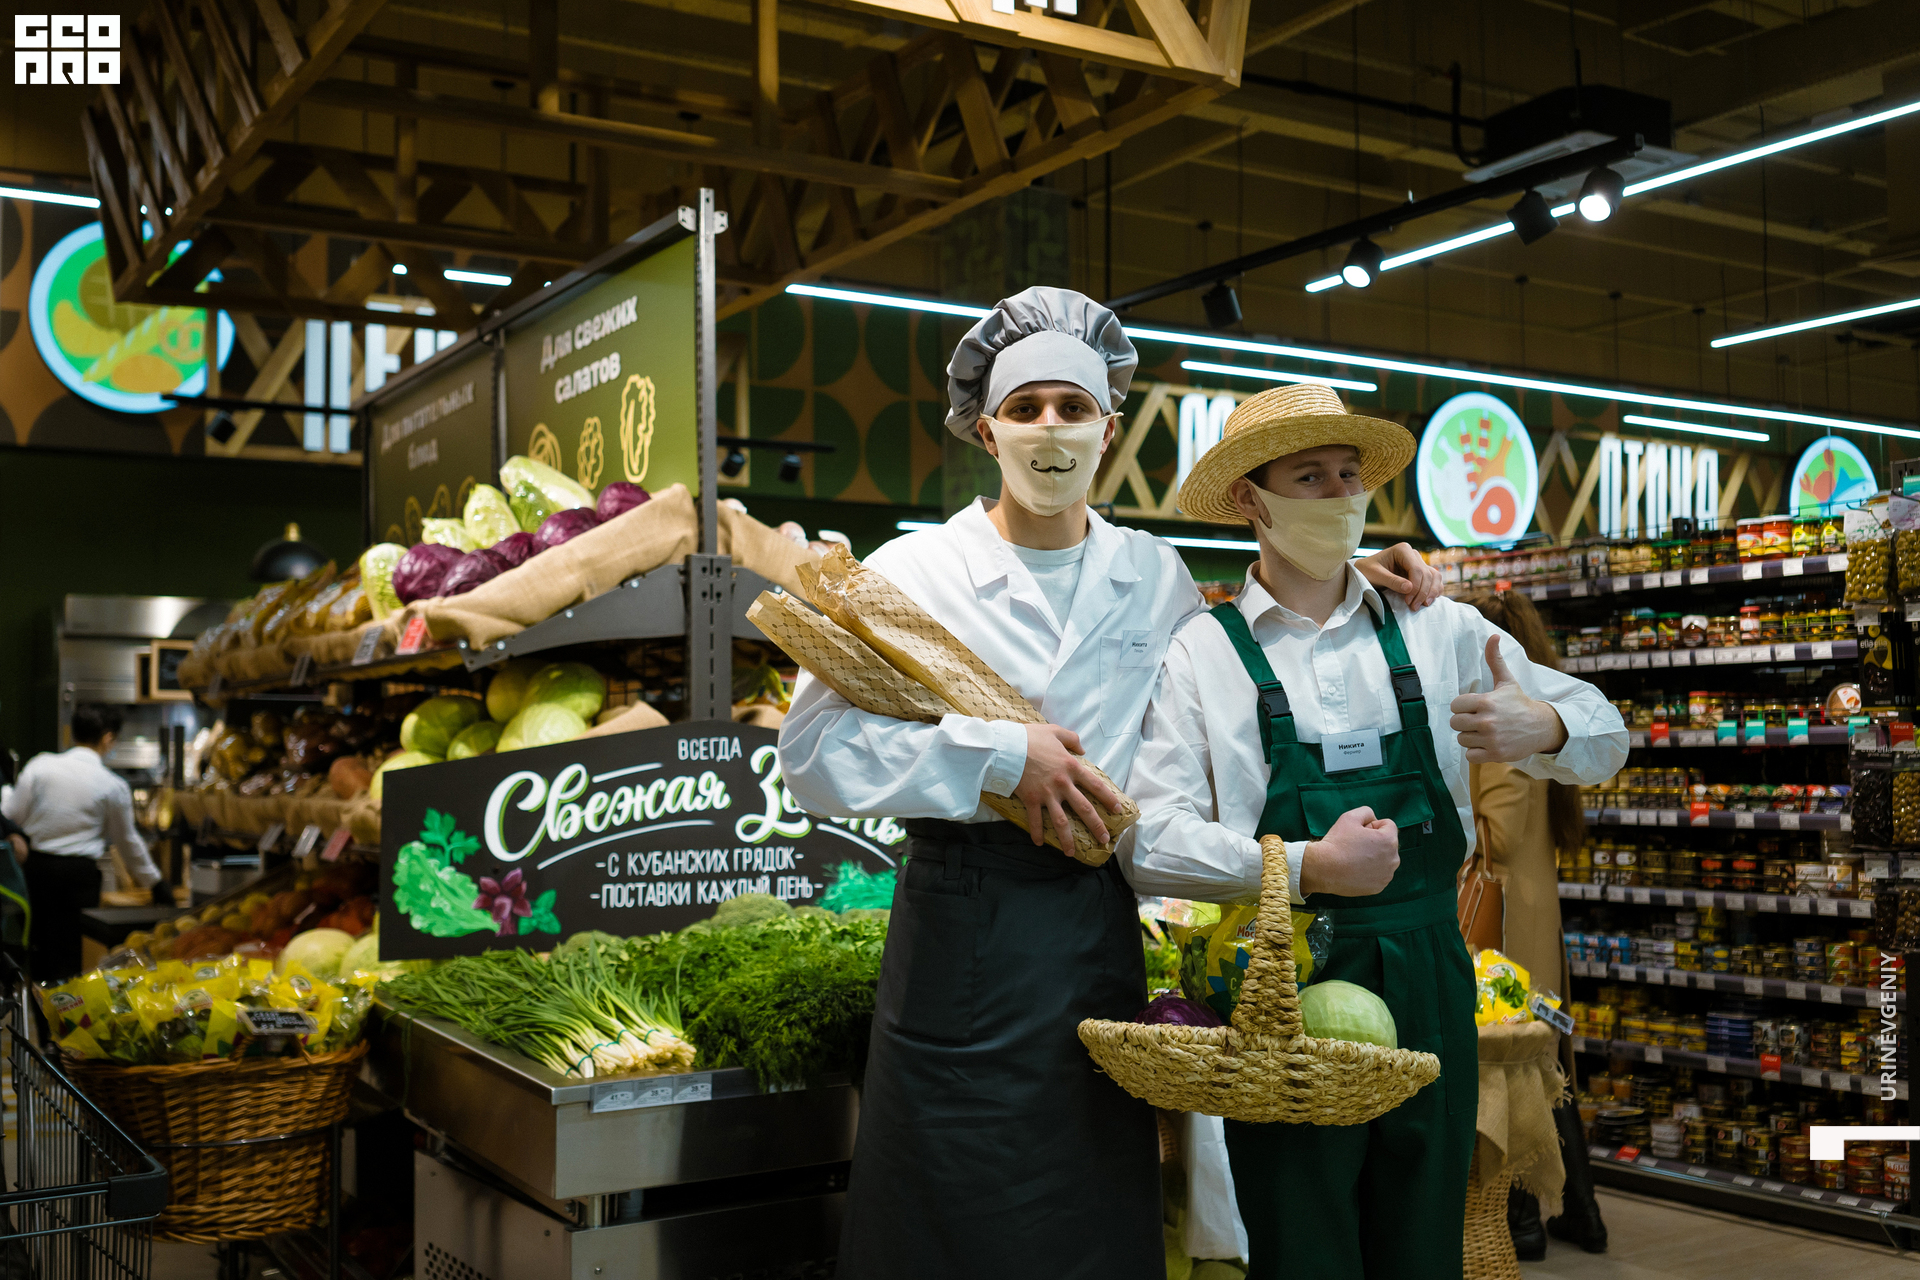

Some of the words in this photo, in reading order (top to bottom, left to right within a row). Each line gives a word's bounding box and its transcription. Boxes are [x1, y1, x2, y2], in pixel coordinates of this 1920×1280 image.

[541, 334, 573, 374] Для
[574, 295, 638, 350] свежих
[554, 351, 621, 404] салатов
[1599, 437, 1719, 540] ПТИЦА
[678, 736, 742, 762] ВСЕГДА
[1338, 742, 1365, 750] Никита
[484, 763, 731, 862] Свежая
[627, 848, 729, 877] КУБАНСКИХ
